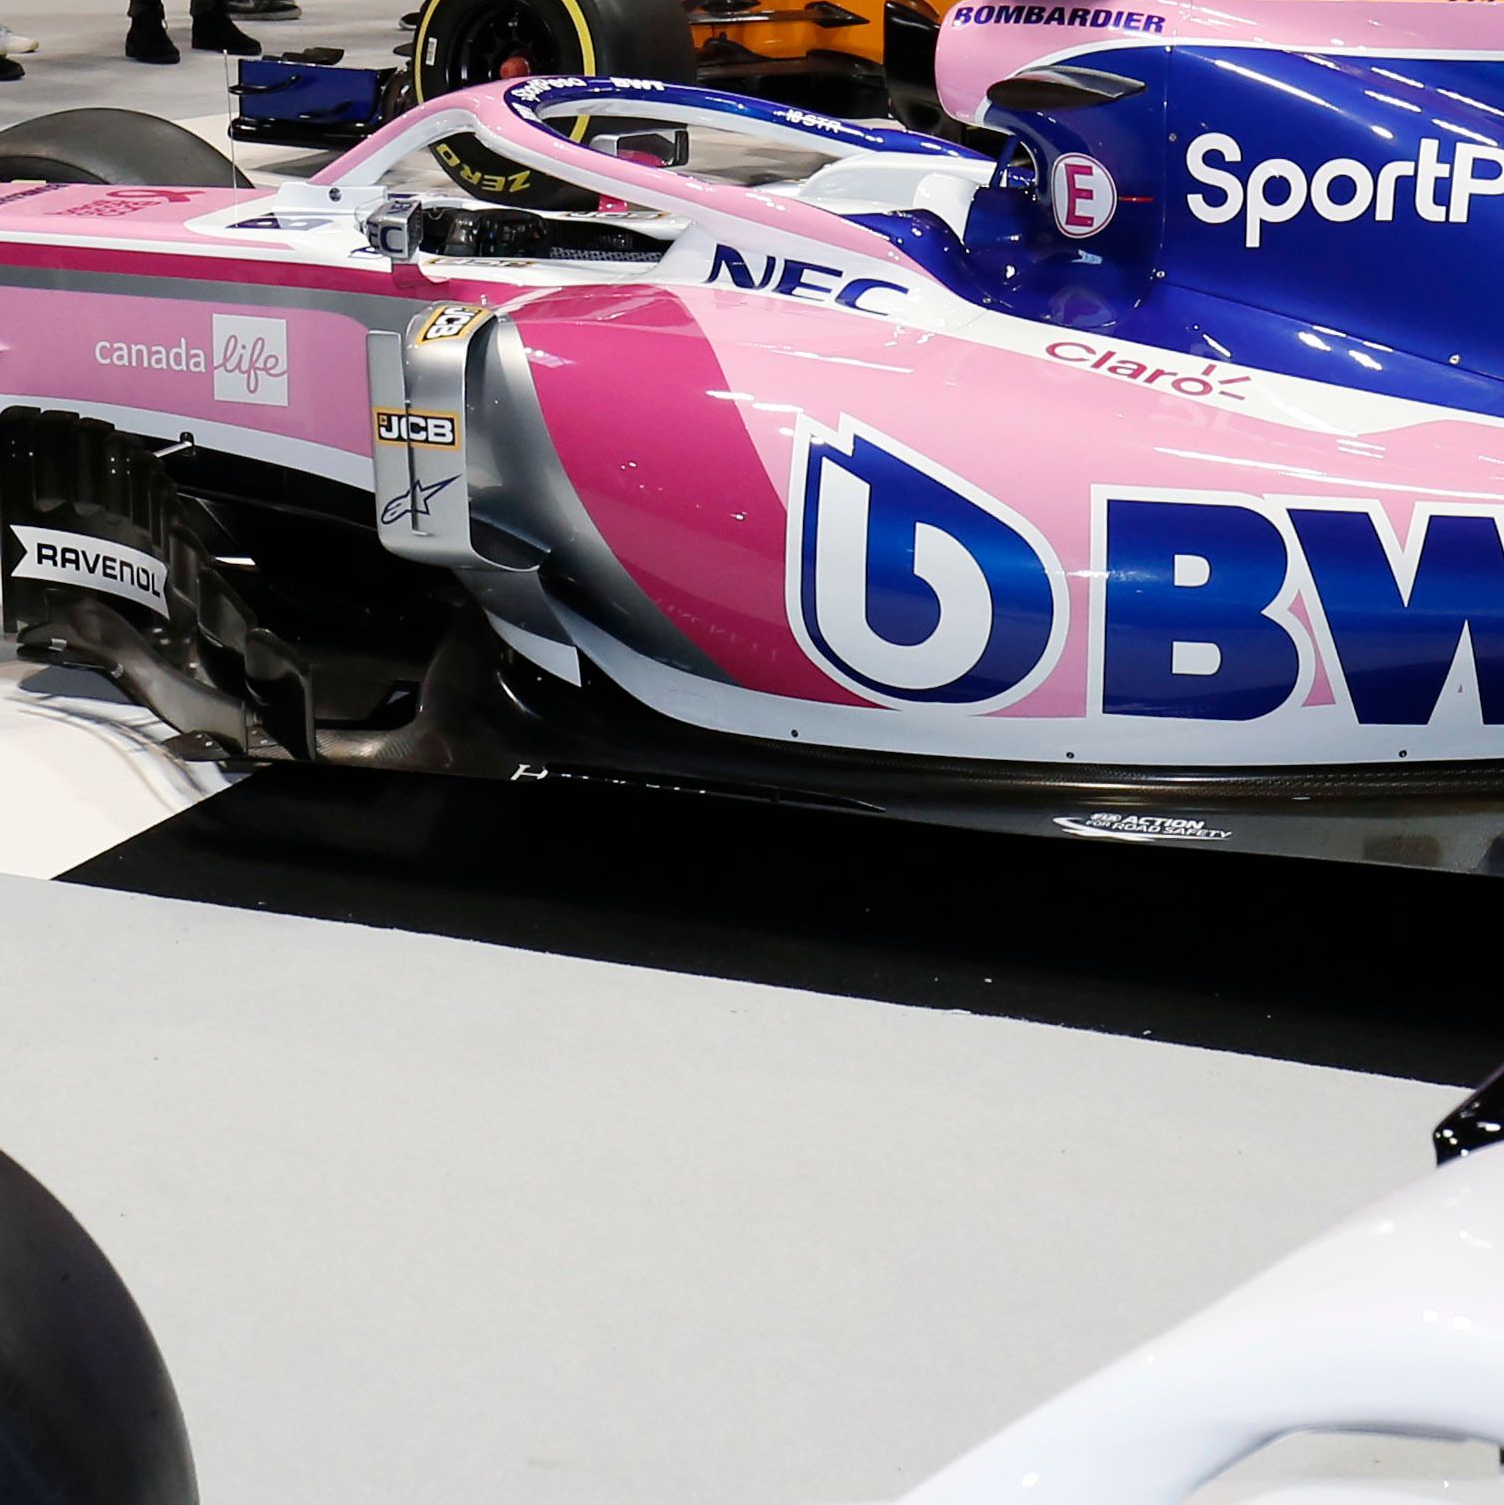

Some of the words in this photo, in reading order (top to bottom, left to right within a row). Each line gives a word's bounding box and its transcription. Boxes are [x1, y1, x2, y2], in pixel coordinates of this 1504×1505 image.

[954, 4, 1166, 34] BOMBARDIER
[436, 142, 531, 193] ZERO
[1065, 167, 1094, 226] E
[708, 243, 910, 317] NEC
[425, 306, 477, 340] JCB
[94, 336, 205, 375] canada
[211, 327, 290, 395] life
[1044, 340, 1217, 401] Claro
[378, 414, 455, 444] JCB
[35, 541, 163, 598] RAVENOL
[1111, 822, 1161, 834] ROAD
[1166, 826, 1232, 840] SAFETY
[1121, 815, 1205, 830] ACTION
